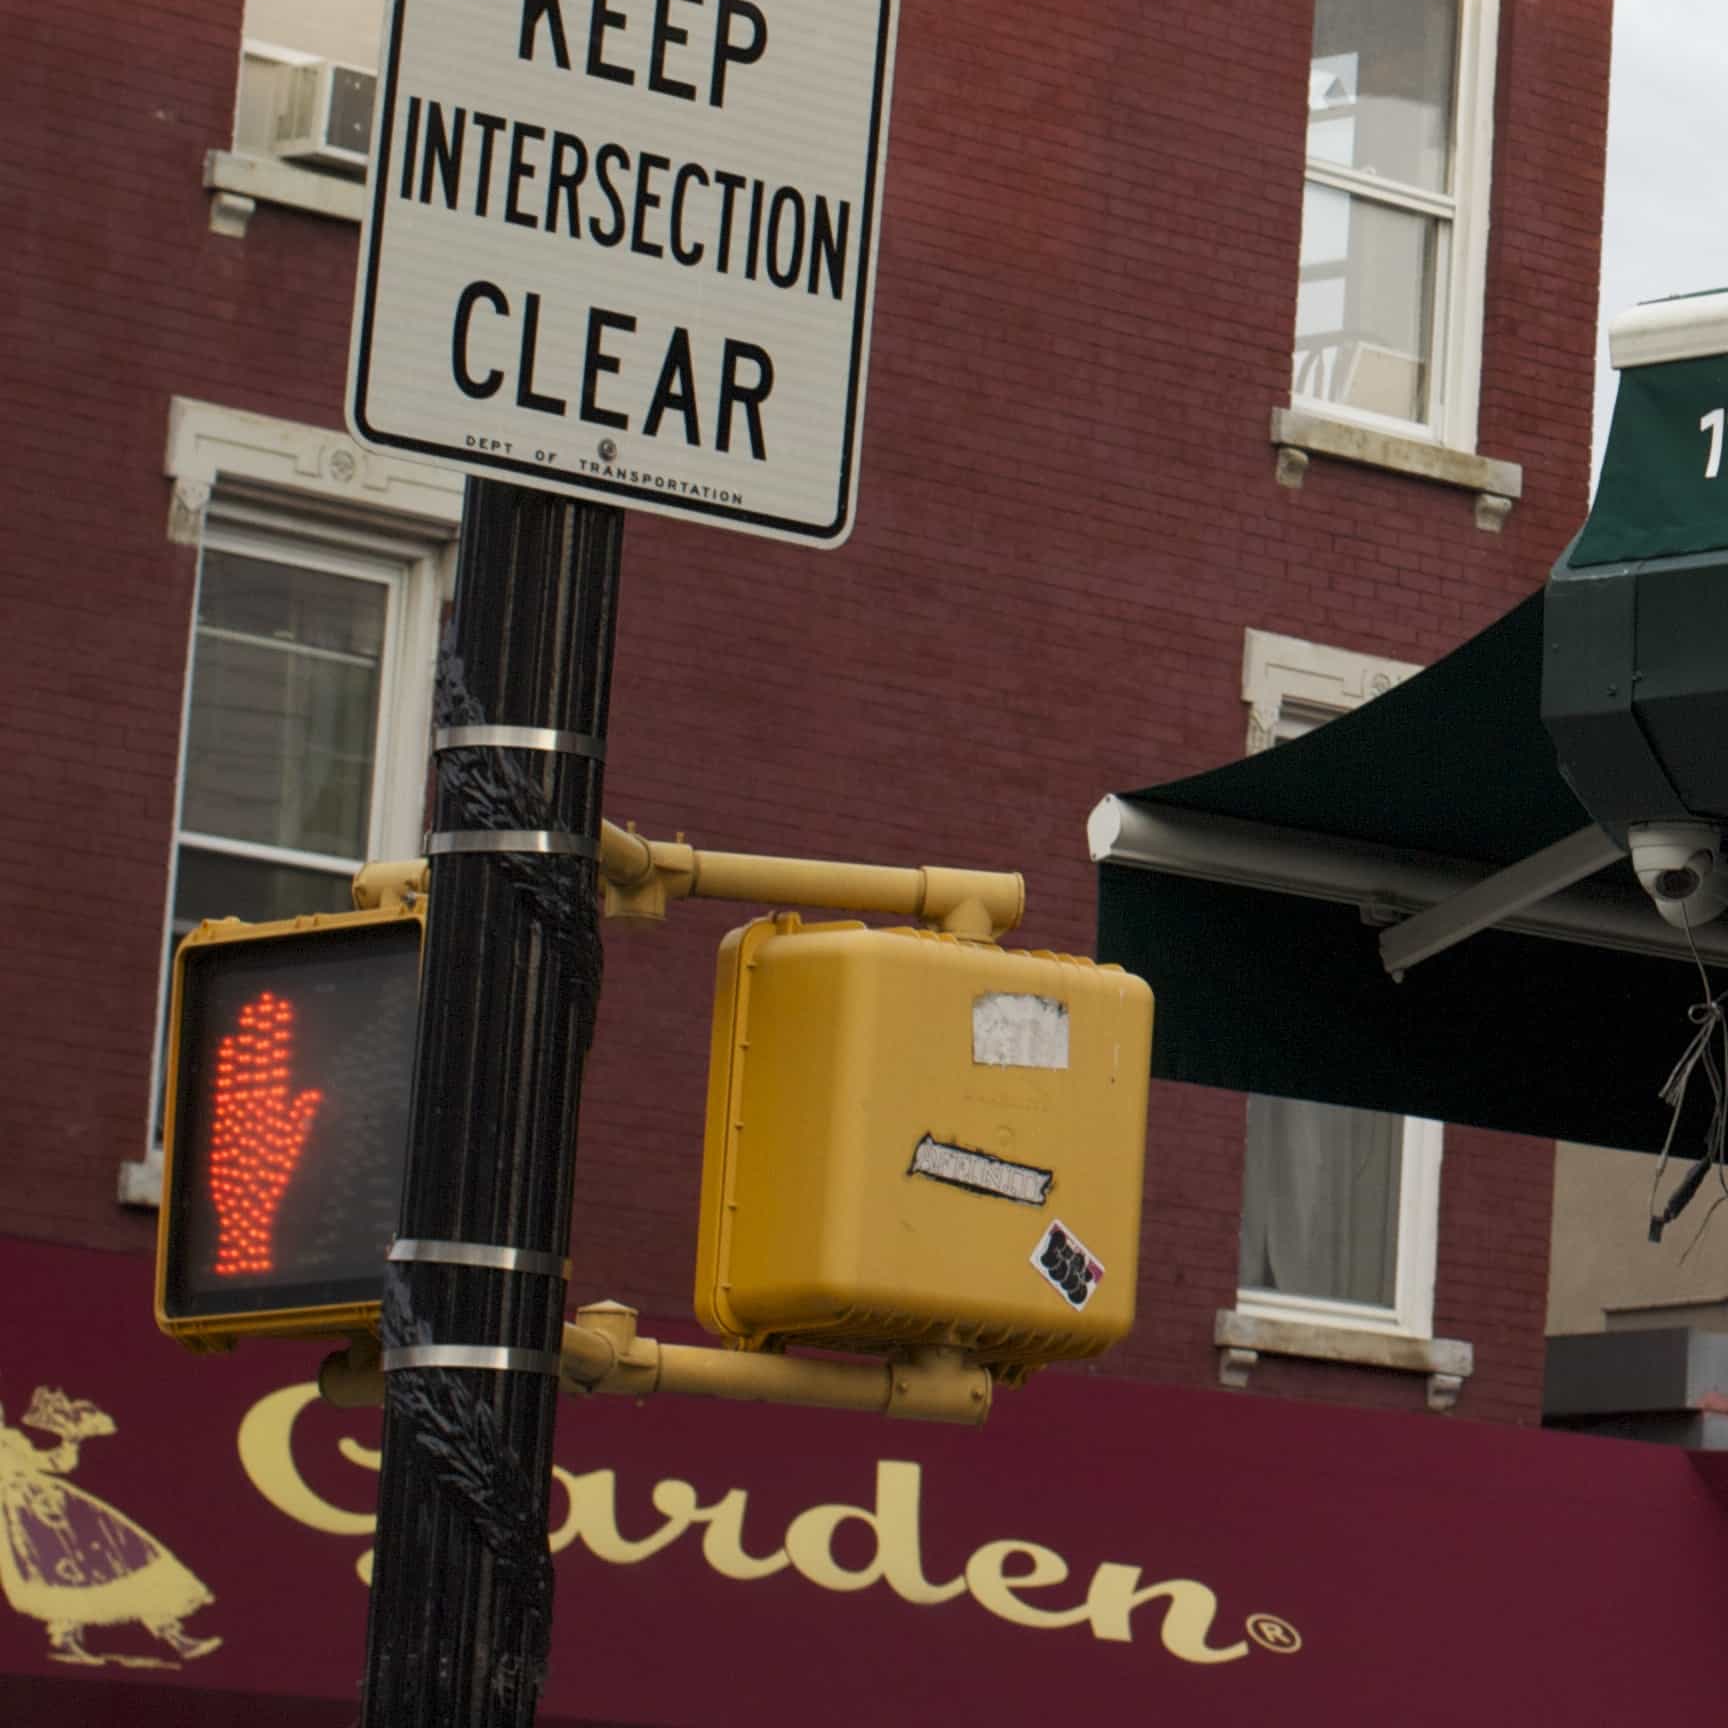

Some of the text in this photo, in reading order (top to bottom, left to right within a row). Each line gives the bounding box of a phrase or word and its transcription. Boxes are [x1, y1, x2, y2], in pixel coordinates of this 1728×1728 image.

[399, 95, 851, 301] INTERSECTION
[451, 279, 775, 462] CLEAR
[465, 434, 744, 506] DEPT OF TRANSPORTATION
